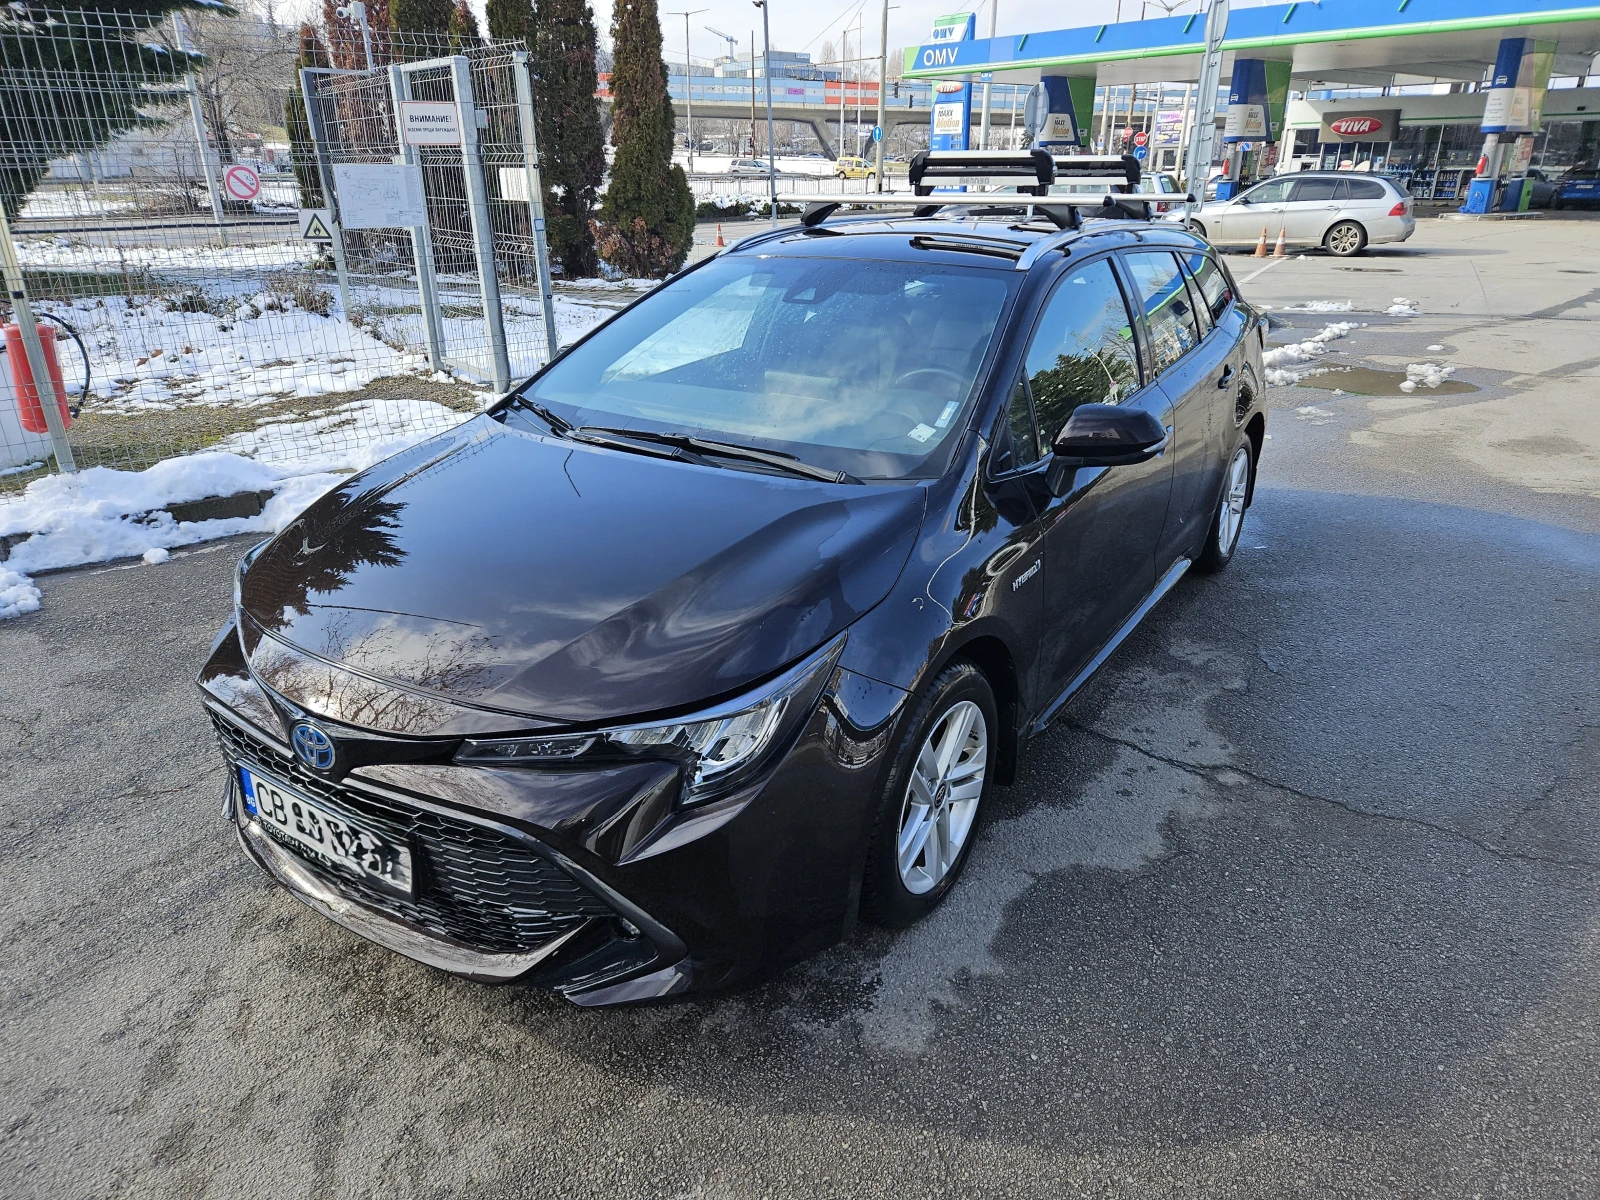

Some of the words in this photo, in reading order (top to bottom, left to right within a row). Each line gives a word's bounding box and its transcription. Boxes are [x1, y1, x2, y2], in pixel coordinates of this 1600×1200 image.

[933, 27, 955, 39] OMV
[923, 47, 959, 66] OMV
[940, 83, 956, 92] VIVA
[409, 114, 452, 123] ВНИМАНИЕ!
[936, 118, 959, 128] Motion
[1340, 119, 1371, 133] VIVA
[1012, 563, 1038, 592] HYBRID
[245, 794, 256, 808] BG
[256, 781, 287, 825] CB
